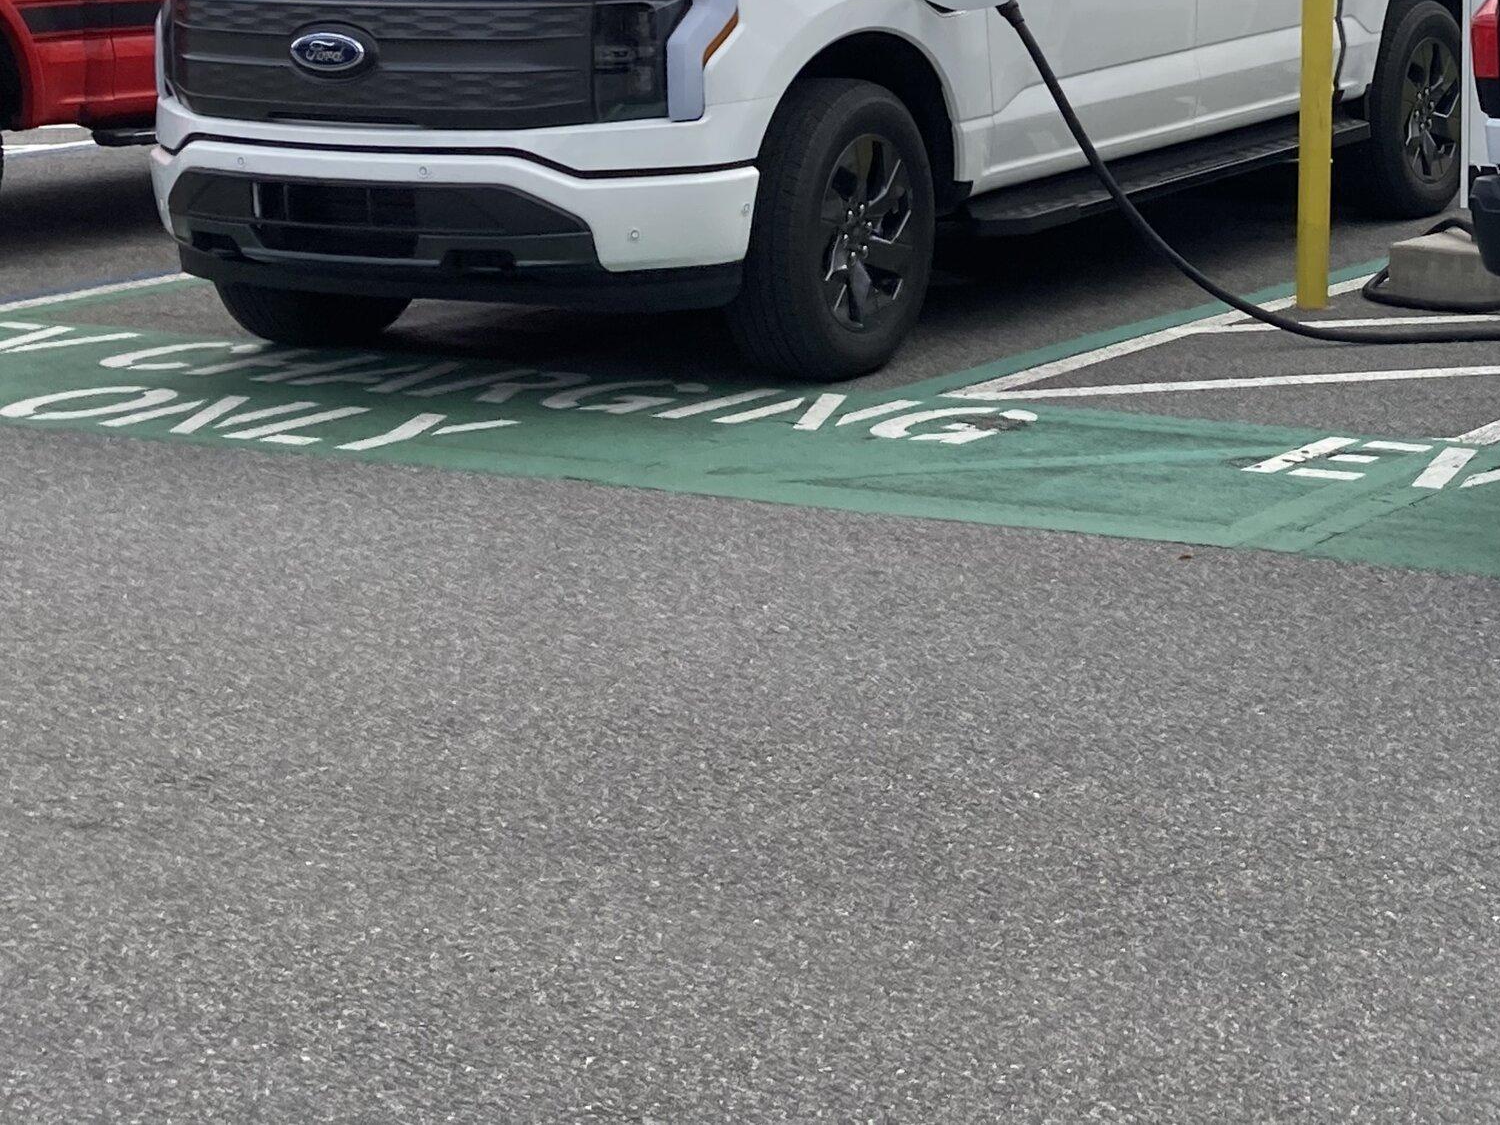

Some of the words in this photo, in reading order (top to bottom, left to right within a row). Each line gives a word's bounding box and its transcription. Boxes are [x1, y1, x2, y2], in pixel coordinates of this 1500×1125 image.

[305, 40, 346, 62] Ford
[0, 385, 522, 451] ONLY
[100, 341, 1039, 445] CHARGING
